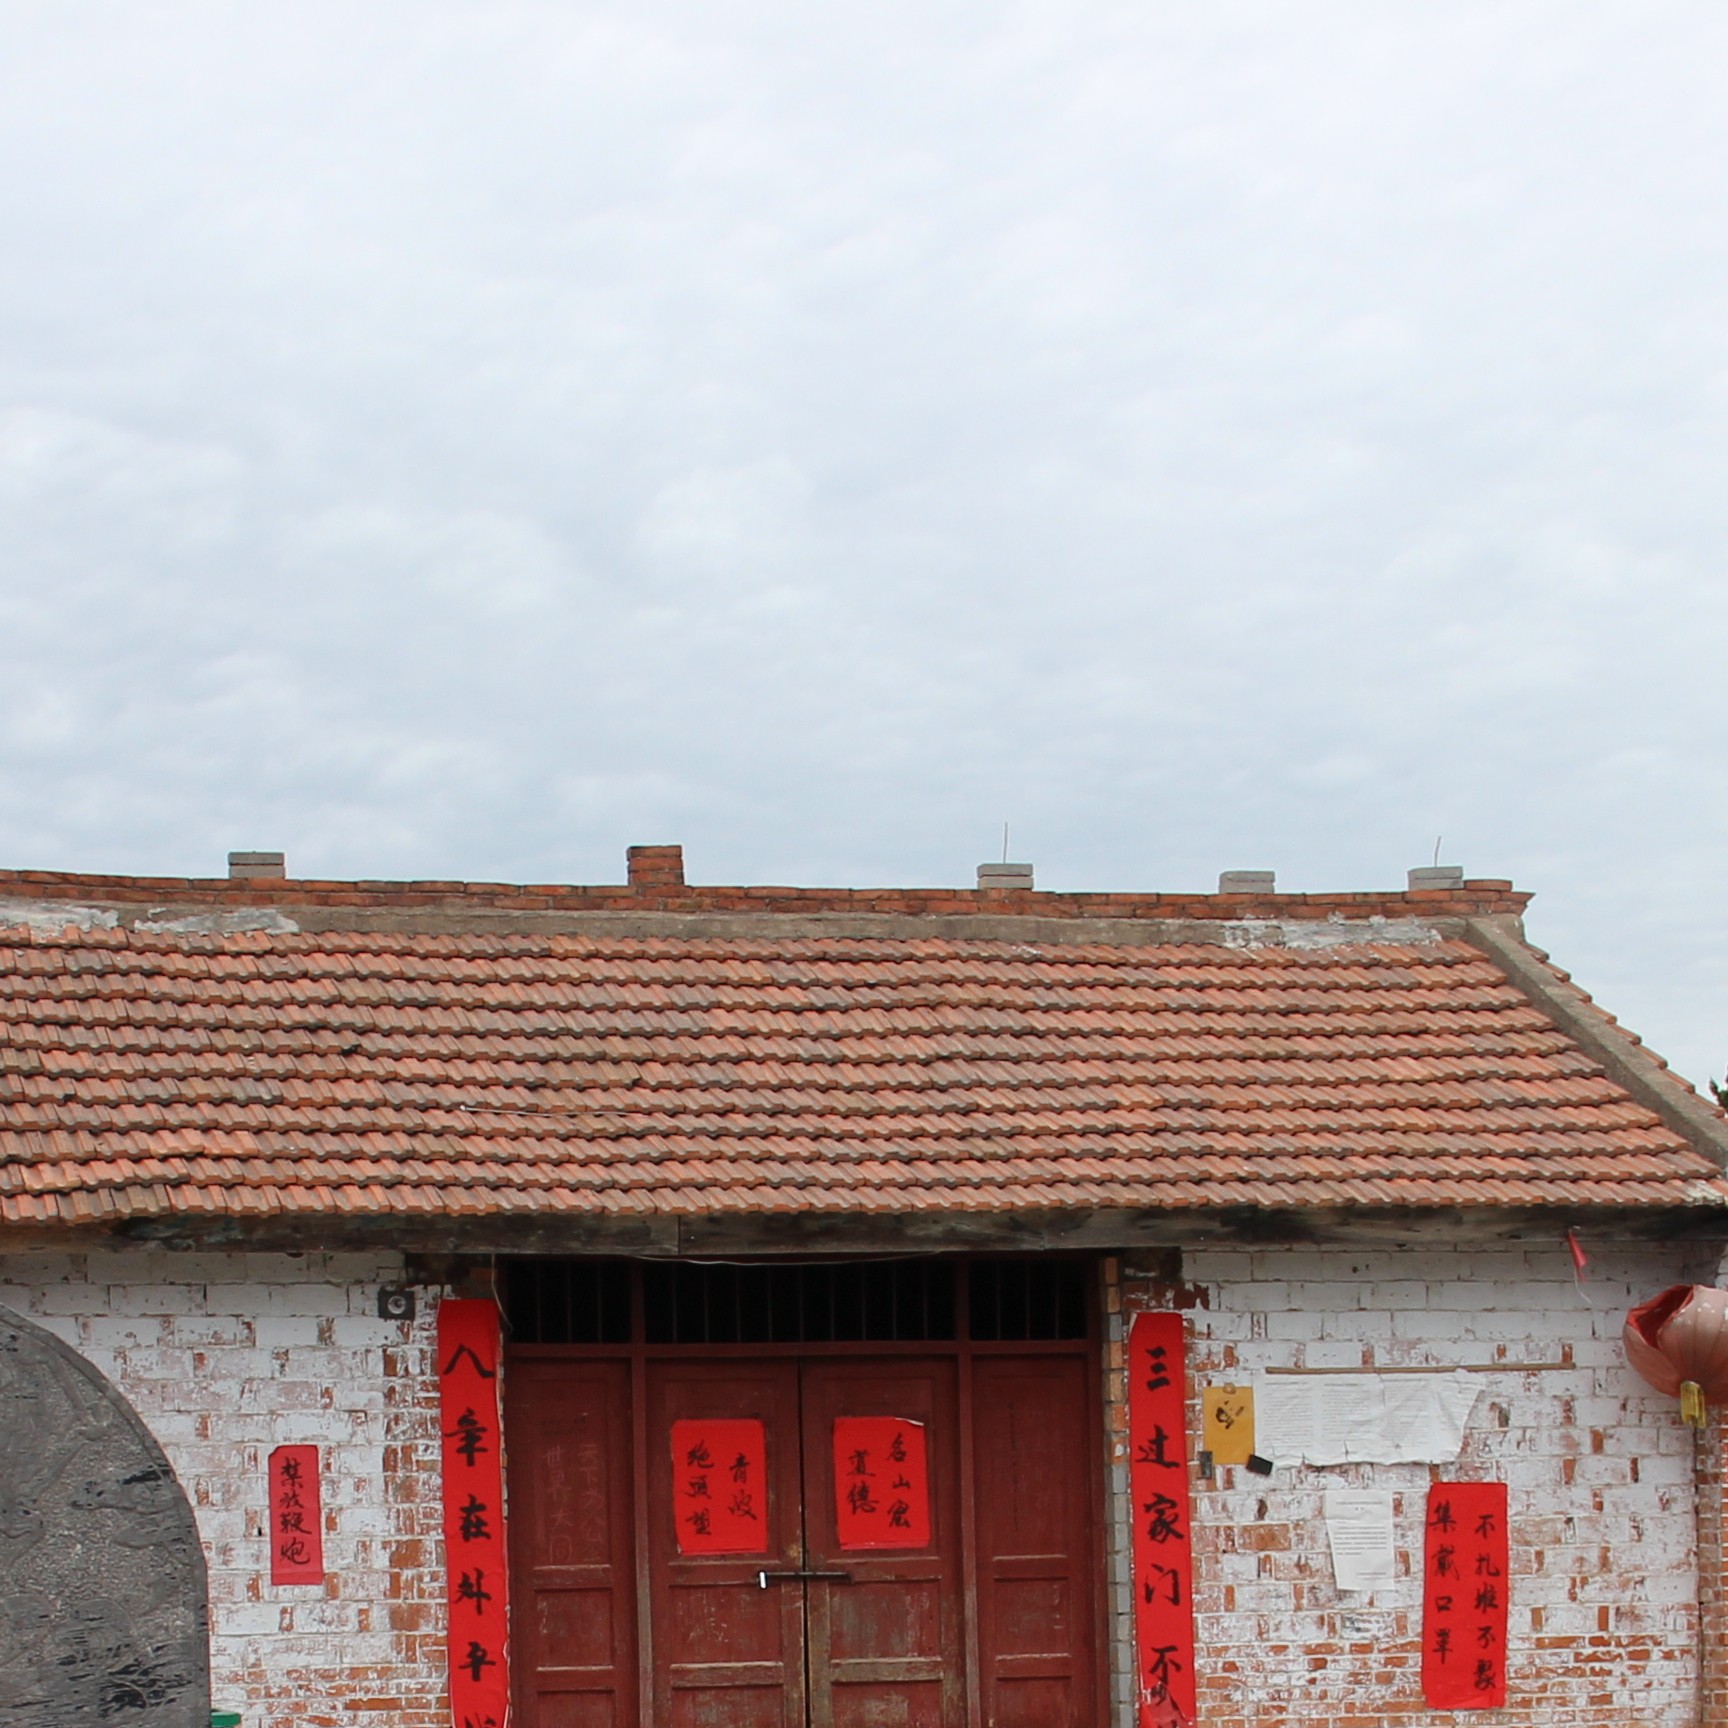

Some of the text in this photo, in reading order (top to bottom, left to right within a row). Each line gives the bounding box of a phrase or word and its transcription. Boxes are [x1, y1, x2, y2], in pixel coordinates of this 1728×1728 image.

[279, 1456, 313, 1565] 禁放鞭炮
[1428, 1500, 1460, 1664] 集戴口罩
